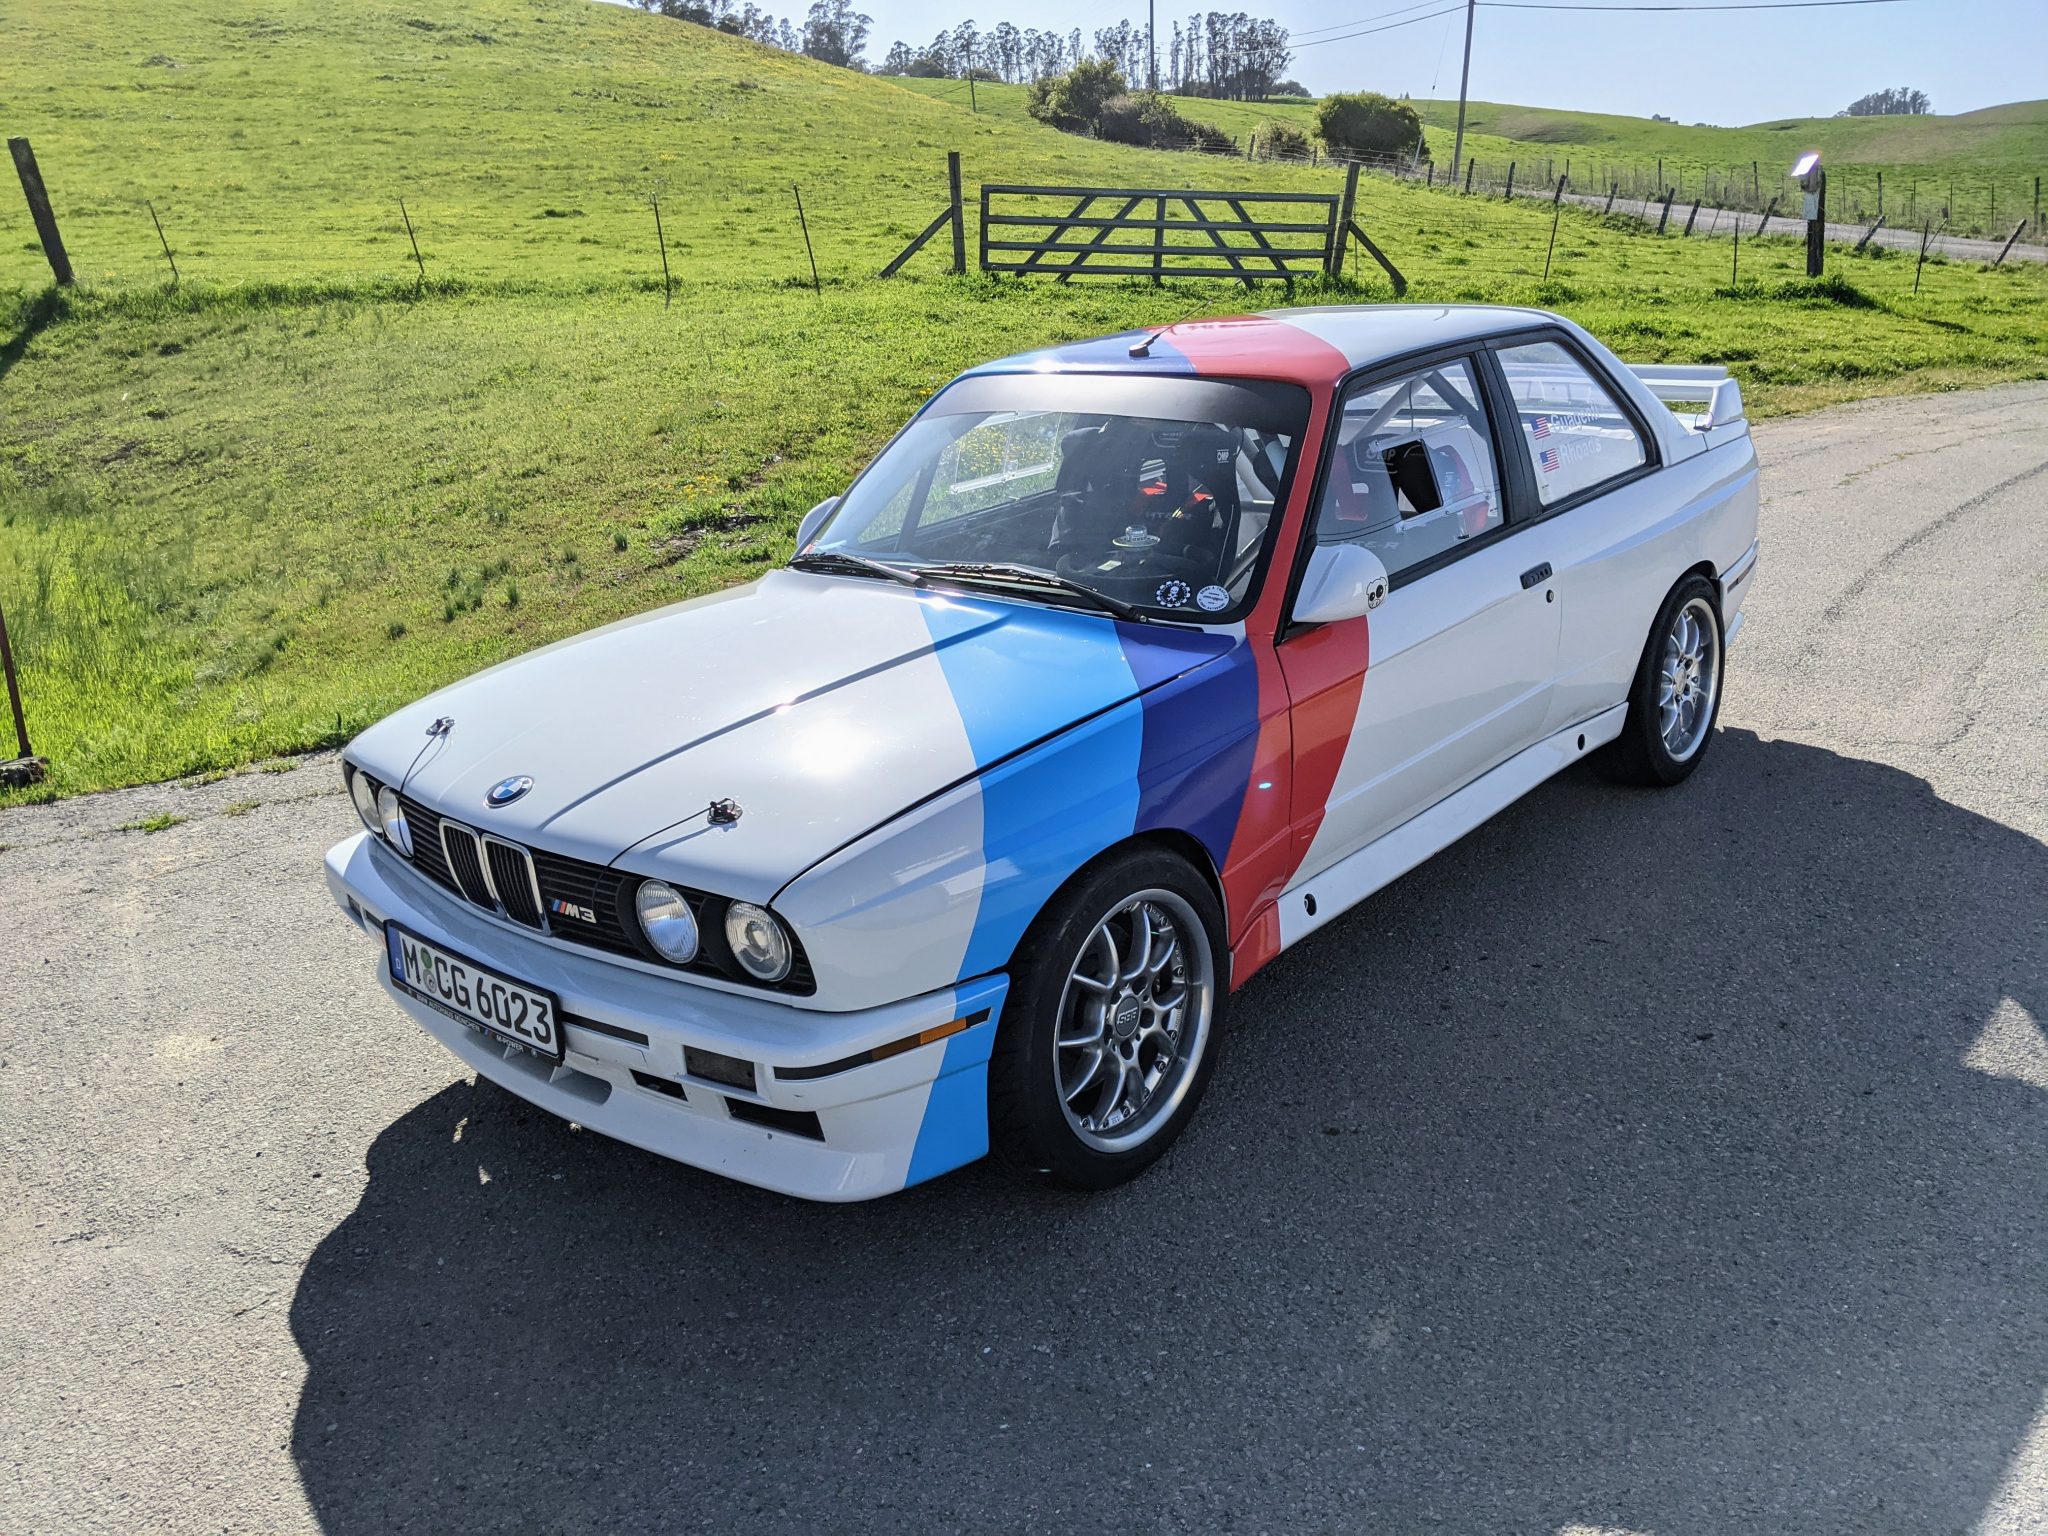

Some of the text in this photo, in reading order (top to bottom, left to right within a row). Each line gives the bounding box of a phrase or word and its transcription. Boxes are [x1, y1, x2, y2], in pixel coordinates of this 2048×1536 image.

[1217, 451, 1229, 461] OMP
[1559, 437, 1602, 465] Rhoads
[564, 903, 597, 924] M3
[402, 938, 551, 1045] M CG 6023
[496, 1034, 524, 1053] M-POWER
